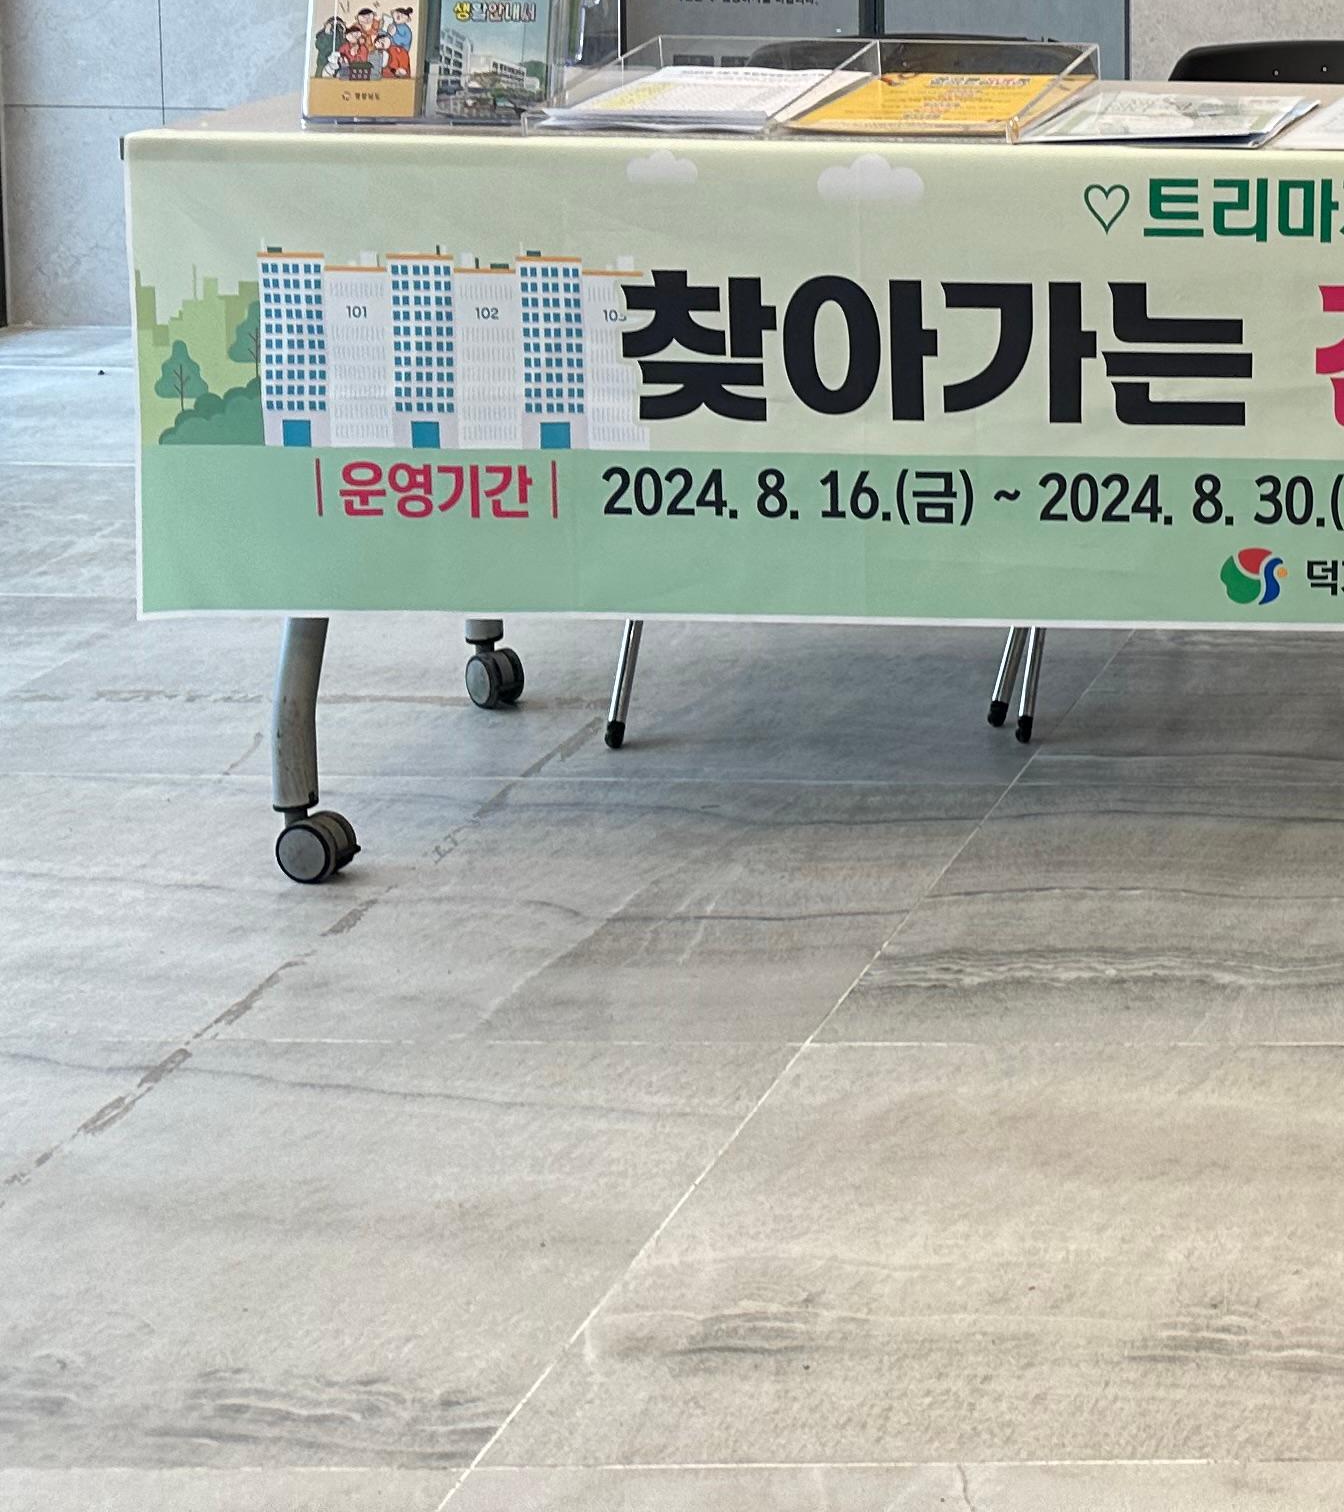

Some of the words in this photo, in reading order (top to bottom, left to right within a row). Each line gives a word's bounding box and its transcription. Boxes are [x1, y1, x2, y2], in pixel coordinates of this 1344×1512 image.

[346, 305, 368, 319] 101
[475, 307, 499, 320] 102
[620, 270, 1253, 427] 찾아가는
[340, 460, 533, 519] 운영기간
[602, 465, 738, 519] 2024.
[757, 468, 799, 521] 8.
[819, 467, 975, 525] 16.(금)
[1038, 472, 1173, 526] 2024.
[1192, 474, 1235, 527] 8.
